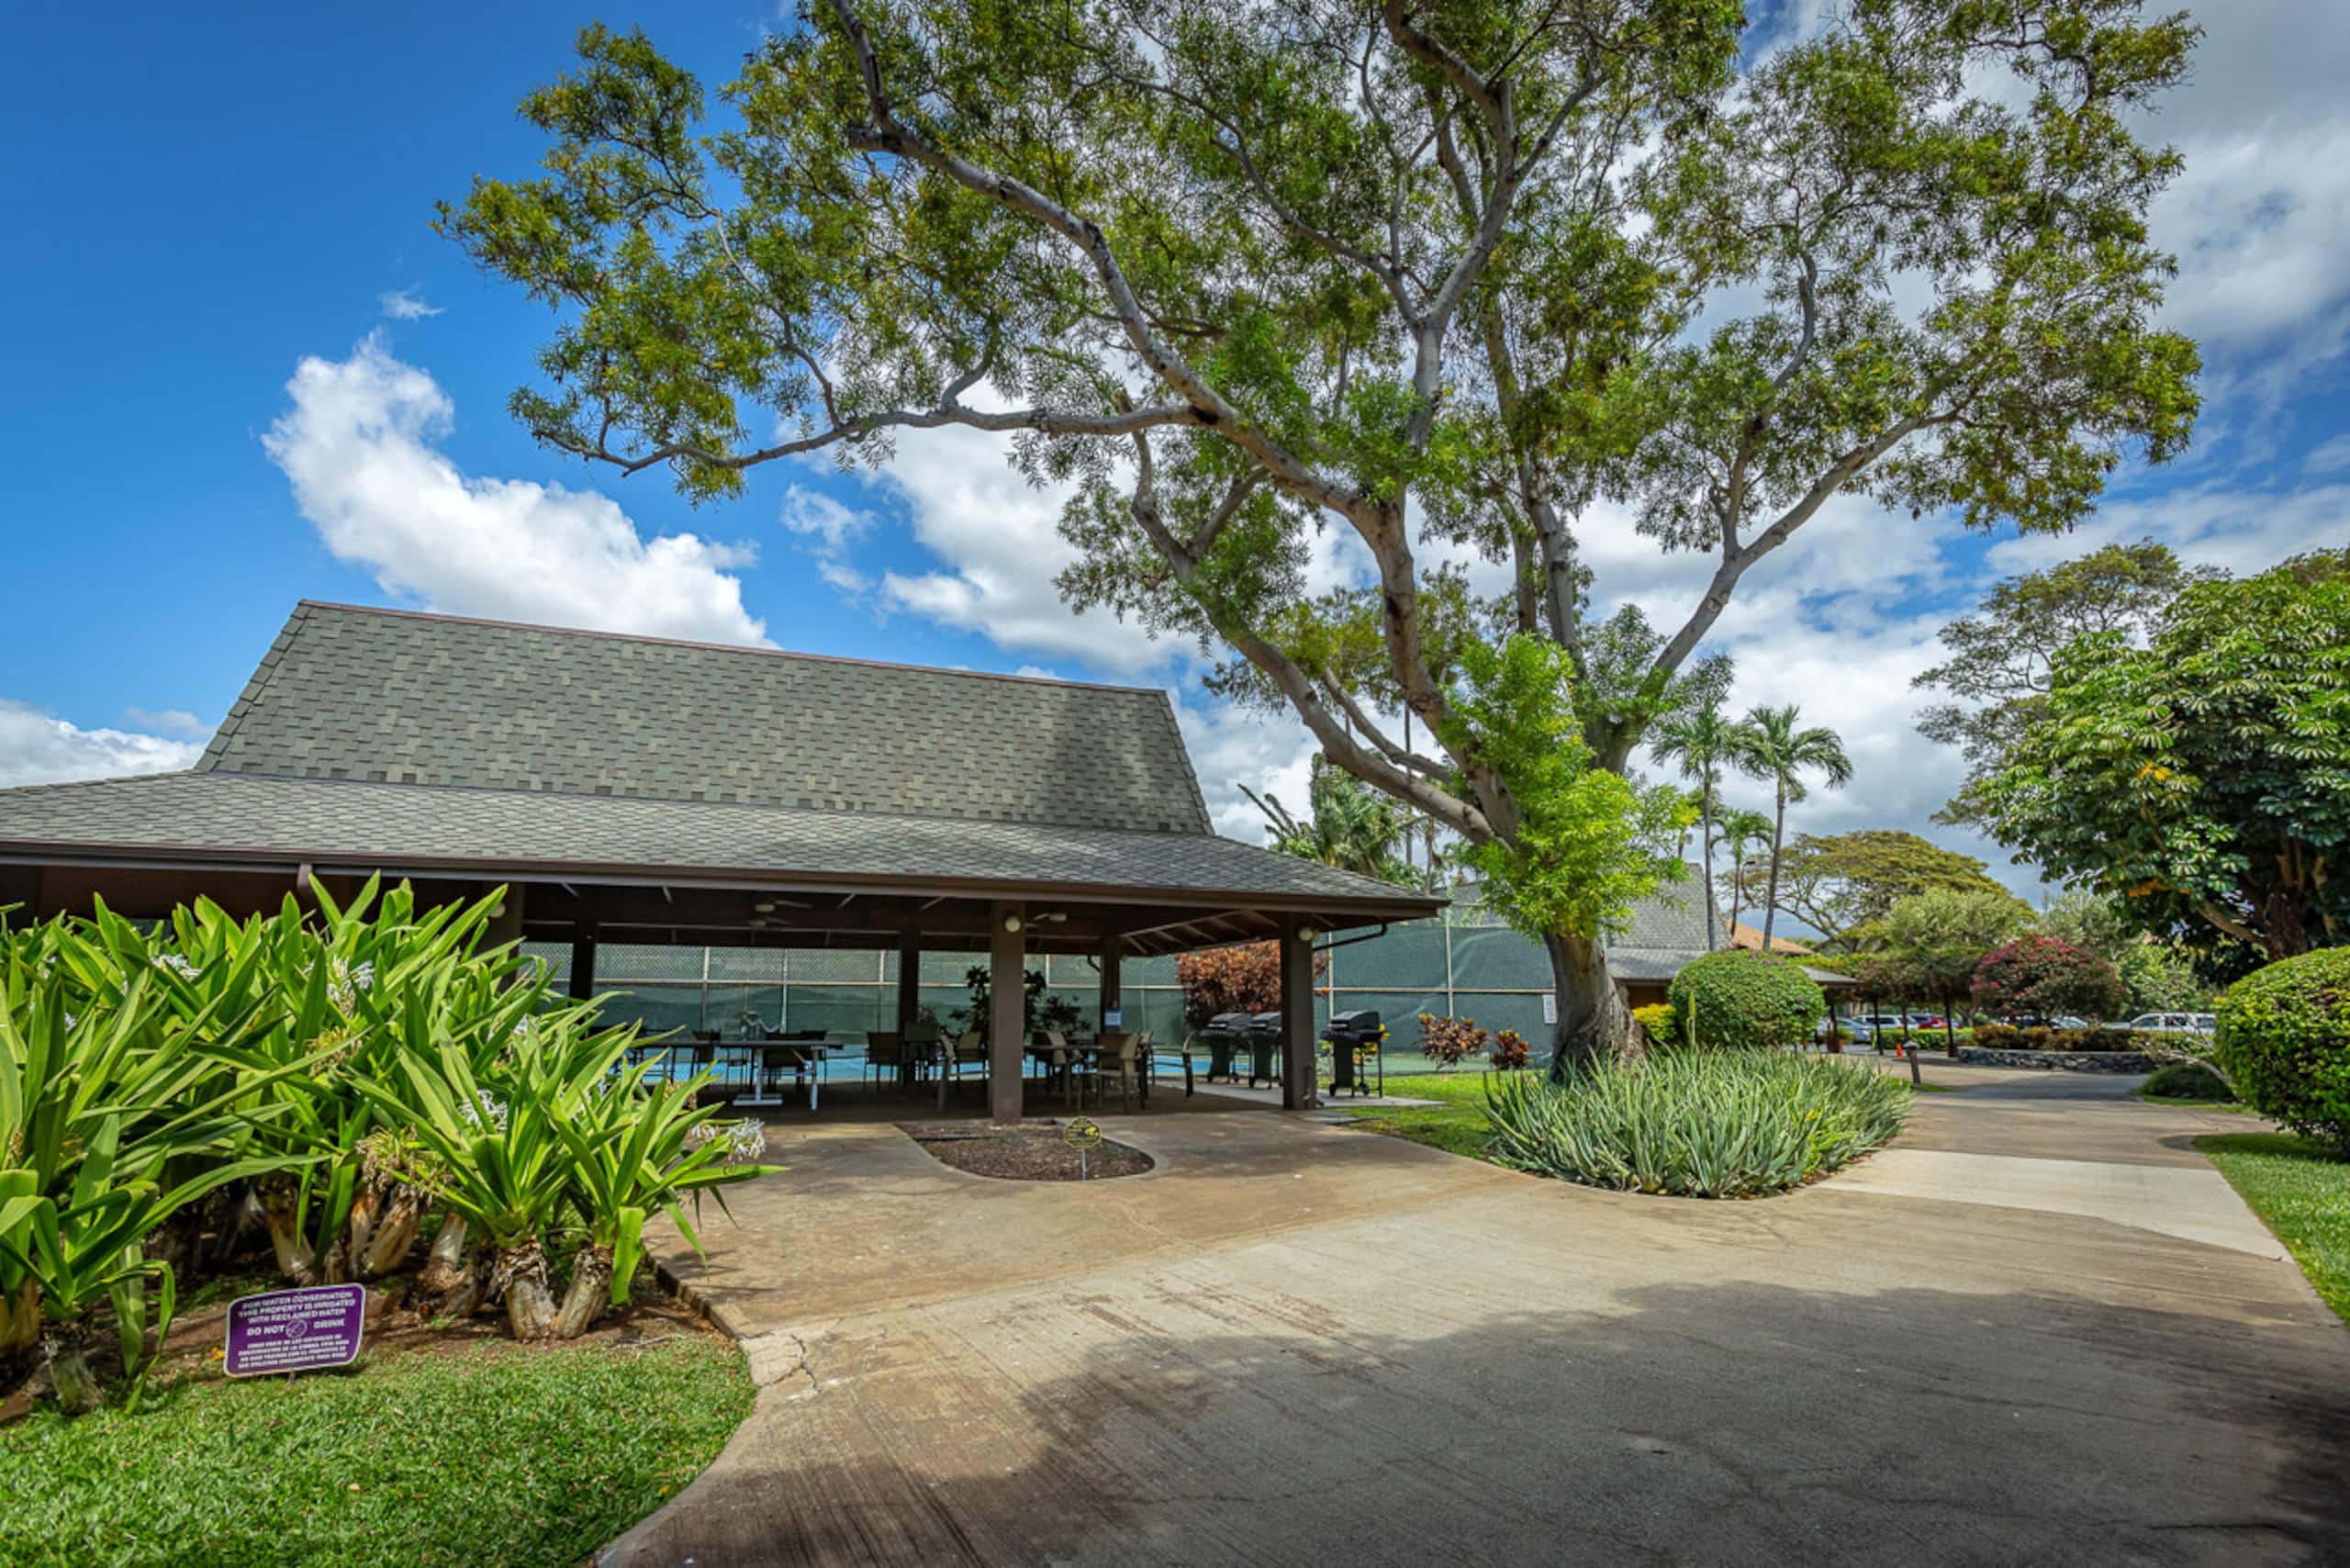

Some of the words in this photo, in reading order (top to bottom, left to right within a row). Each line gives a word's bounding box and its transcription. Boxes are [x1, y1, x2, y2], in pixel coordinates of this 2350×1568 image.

[263, 1296, 290, 1307] WATER
[260, 1303, 303, 1315] PROPERTY
[246, 1327, 262, 1336] DO
[263, 1325, 285, 1335] NOT
[313, 1318, 345, 1329] DRINK
